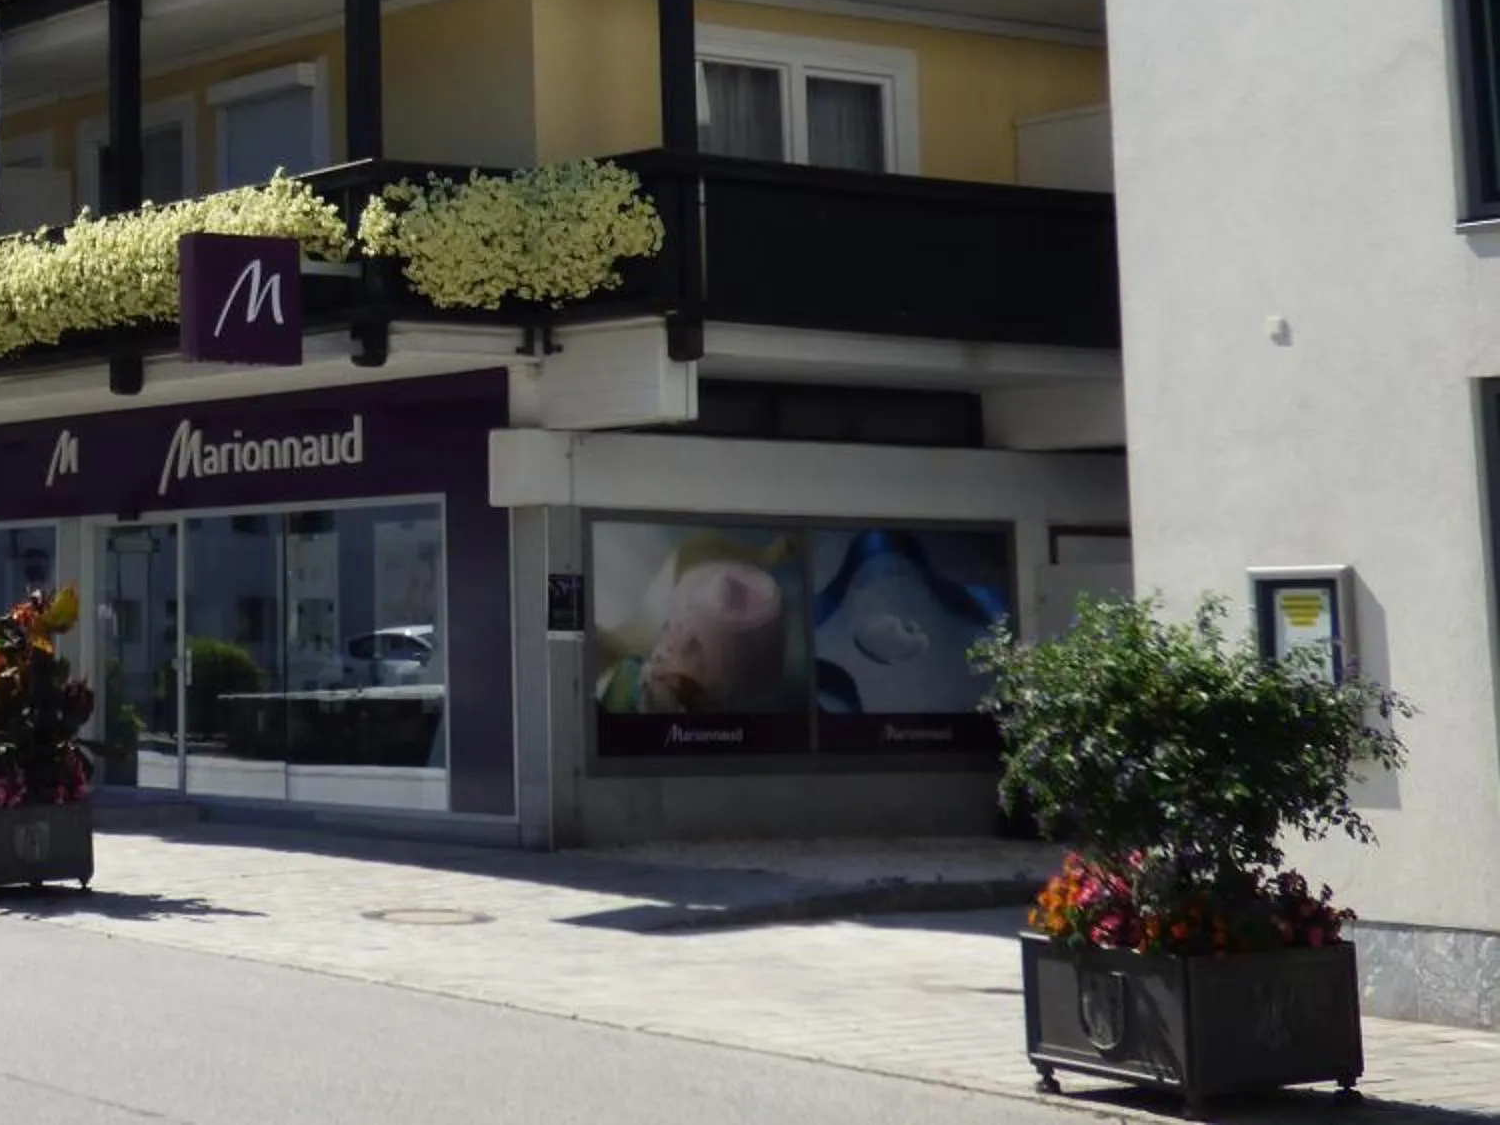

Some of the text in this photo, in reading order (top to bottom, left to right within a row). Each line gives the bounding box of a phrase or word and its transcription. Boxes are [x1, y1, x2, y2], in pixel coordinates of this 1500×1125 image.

[213, 258, 284, 337] M
[46, 429, 79, 486] M
[158, 414, 363, 496] Marionnaud
[663, 723, 744, 748] Marionnaud
